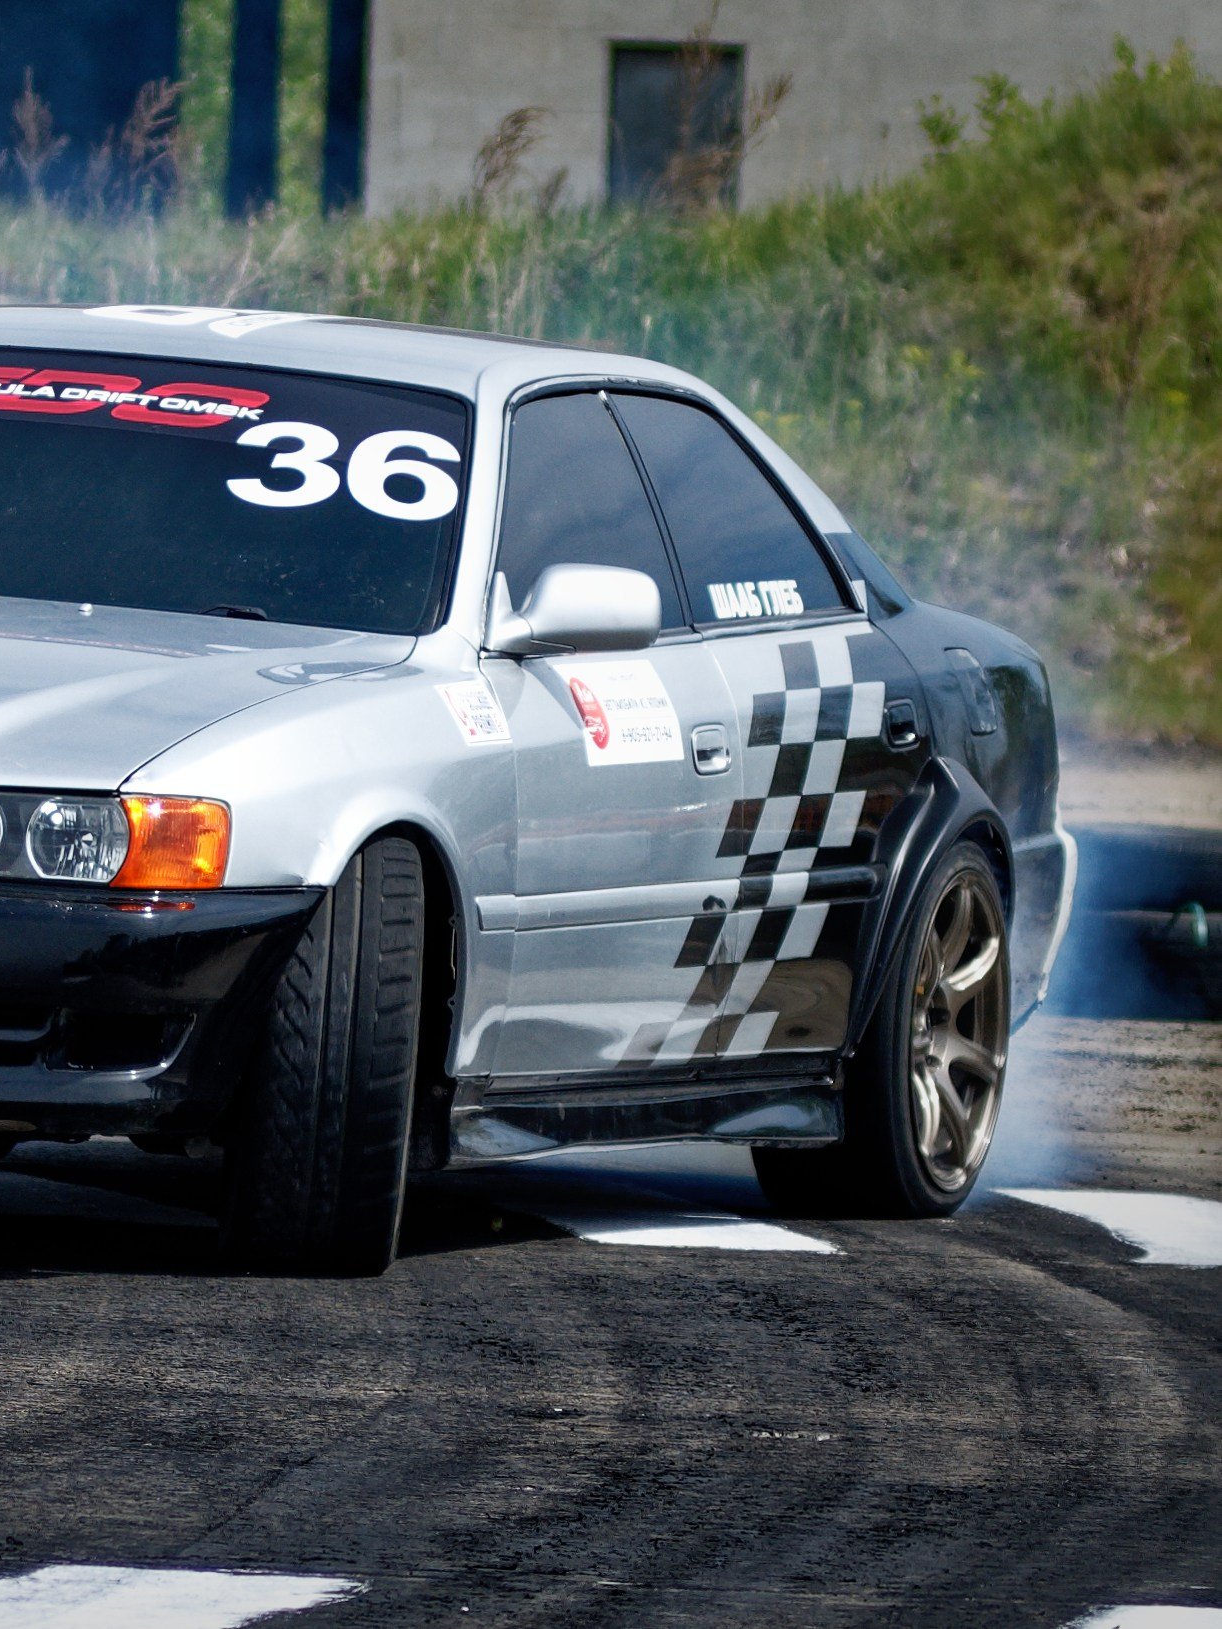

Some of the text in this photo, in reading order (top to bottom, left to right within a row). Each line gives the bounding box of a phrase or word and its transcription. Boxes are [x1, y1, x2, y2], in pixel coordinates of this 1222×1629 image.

[59, 386, 161, 406] DRIFT
[157, 394, 265, 421] OMSK
[226, 421, 461, 521] 36
[757, 579, 804, 616] ГЛЕБ
